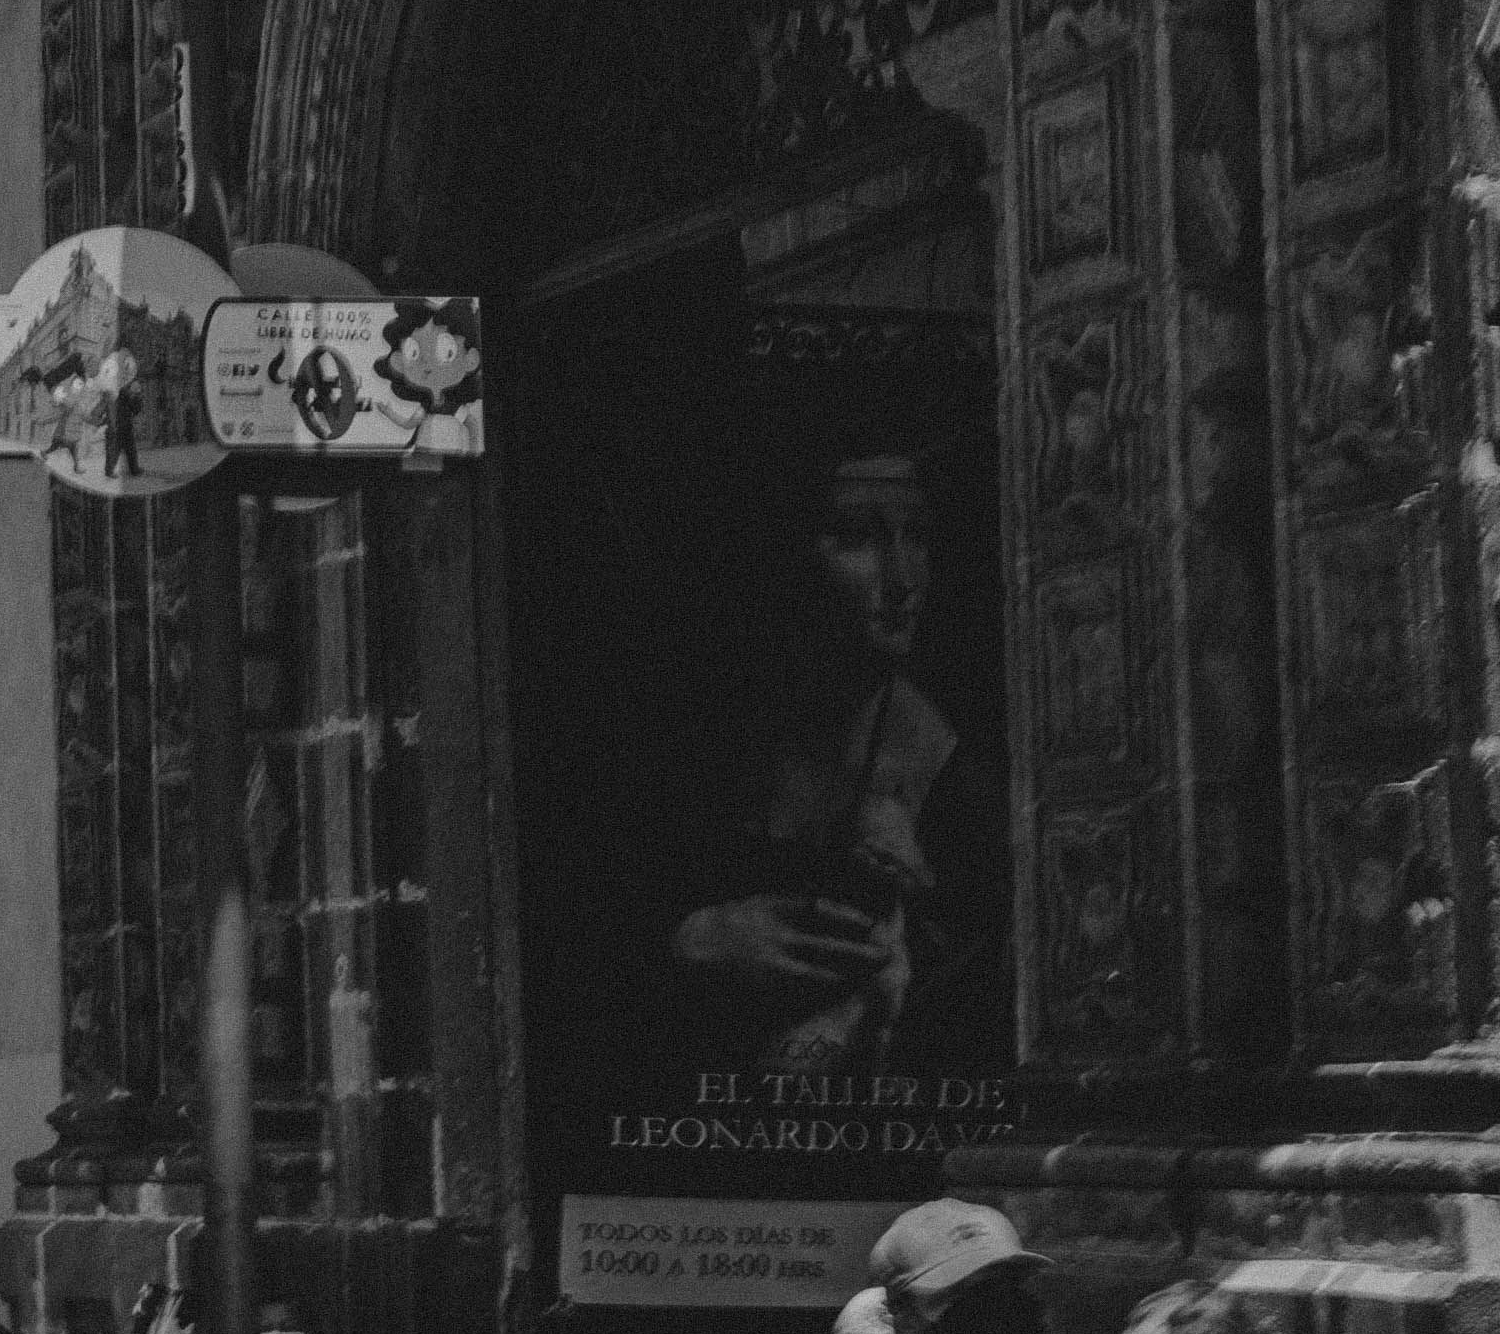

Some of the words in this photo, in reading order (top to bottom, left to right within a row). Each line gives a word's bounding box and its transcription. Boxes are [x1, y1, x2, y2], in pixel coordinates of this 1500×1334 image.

[257, 308, 313, 322] CALLE
[326, 310, 372, 325] 100%
[257, 327, 293, 340] LIBRE
[301, 328, 320, 340] DE
[323, 329, 372, 342] HUMO
[696, 1072, 752, 1105] EL
[762, 1074, 920, 1108] TALLER
[937, 1078, 1006, 1110] DE
[610, 1115, 870, 1151] LEONARDO
[882, 1120, 945, 1152] DA
[579, 1222, 673, 1244] TODOS
[679, 1224, 730, 1245] LOS
[798, 1227, 836, 1249] DE
[580, 1250, 659, 1277] 10:00
[666, 1255, 687, 1277] A
[696, 1251, 772, 1279] 18:00
